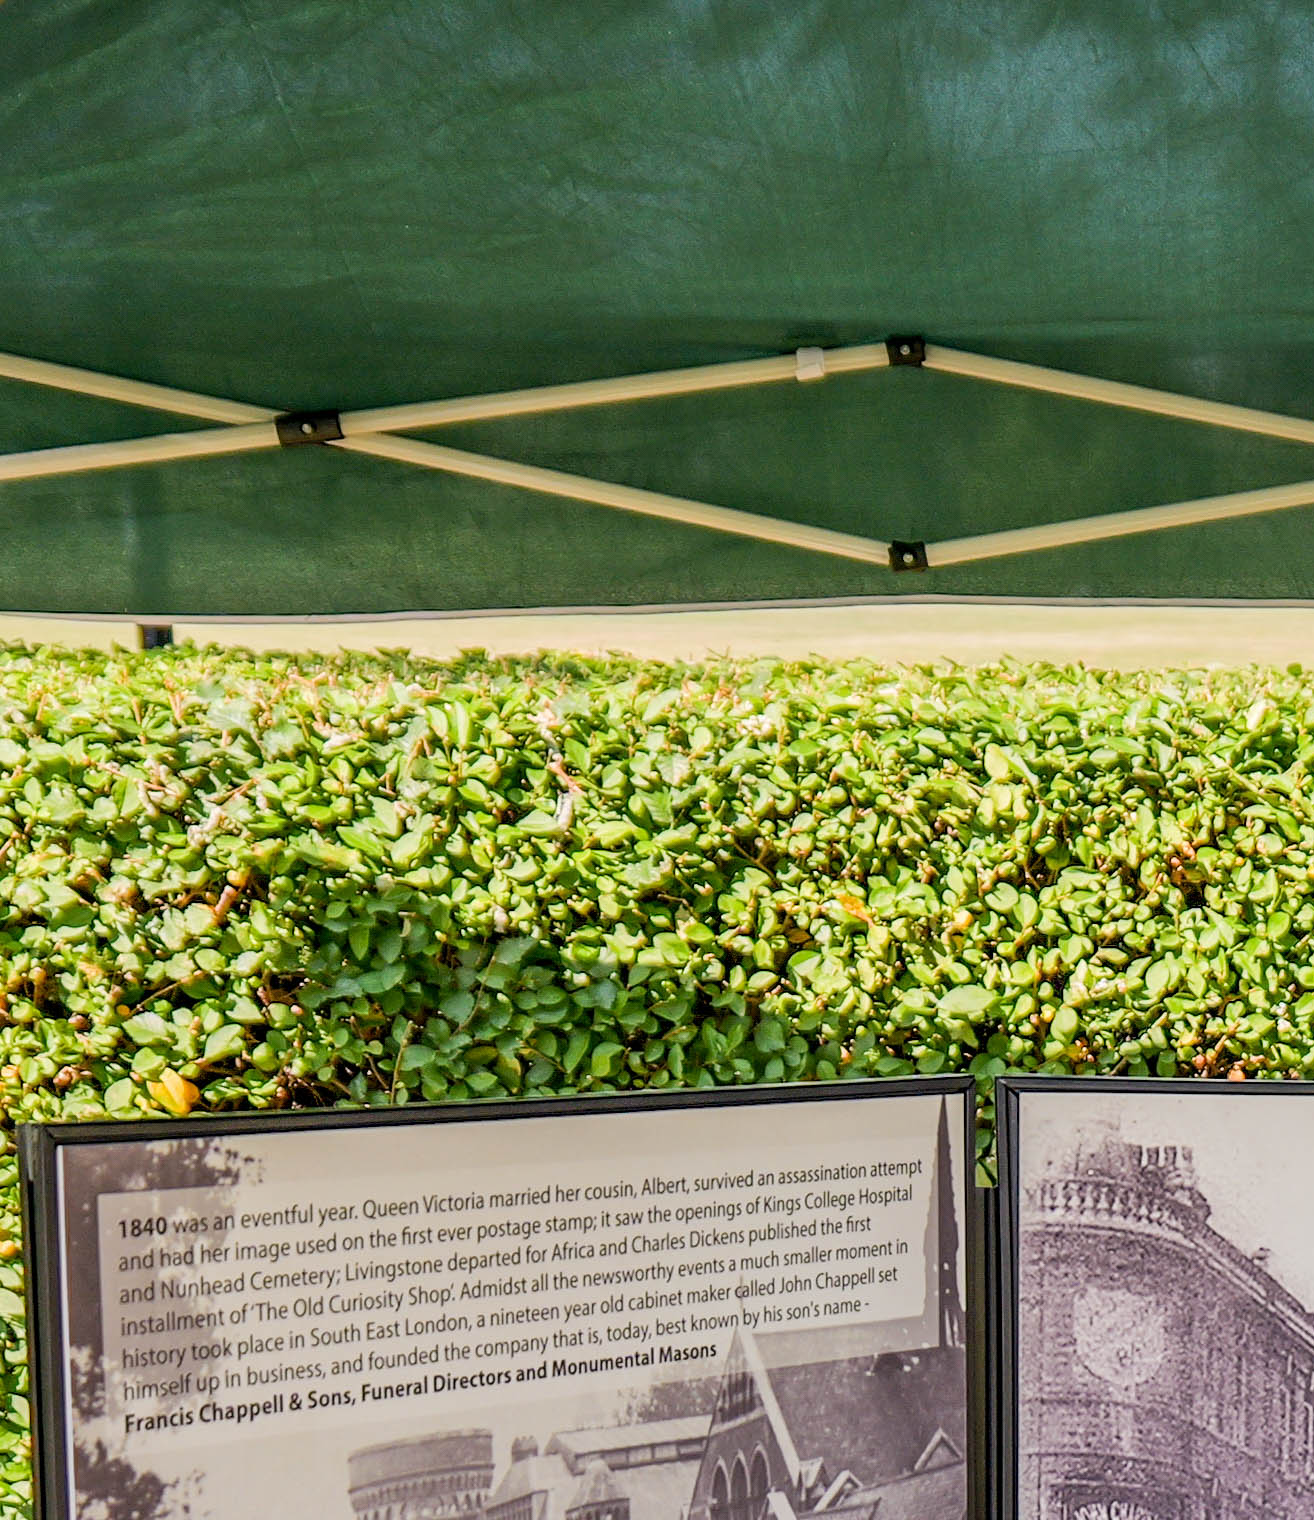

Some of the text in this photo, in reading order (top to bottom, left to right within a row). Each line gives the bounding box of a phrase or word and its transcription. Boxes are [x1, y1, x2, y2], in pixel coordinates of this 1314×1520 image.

[118, 1159, 922, 1239] 1840 was an eventful year. Queen Victoria married her cousin, Albert, survived an assassination attempt
[125, 1344, 717, 1434] Francis Chappell & Sons, Funeral Directors and Monumental Masons
